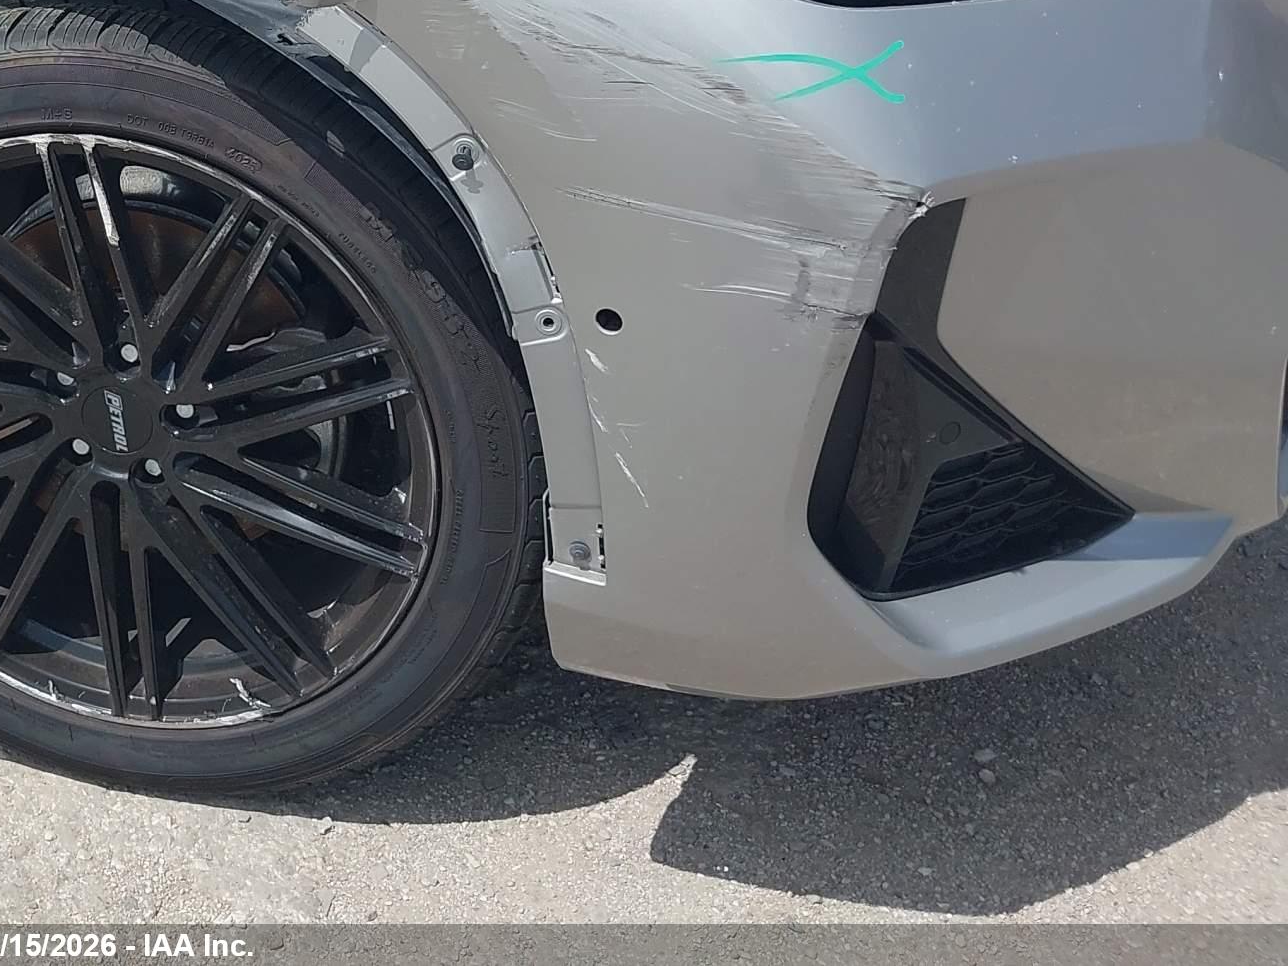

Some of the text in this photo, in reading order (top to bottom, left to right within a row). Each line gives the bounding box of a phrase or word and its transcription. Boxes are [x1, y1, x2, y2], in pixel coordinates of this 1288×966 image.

[40, 107, 74, 121] M+S
[126, 113, 149, 127] DOT
[103, 389, 130, 453] PETROL
